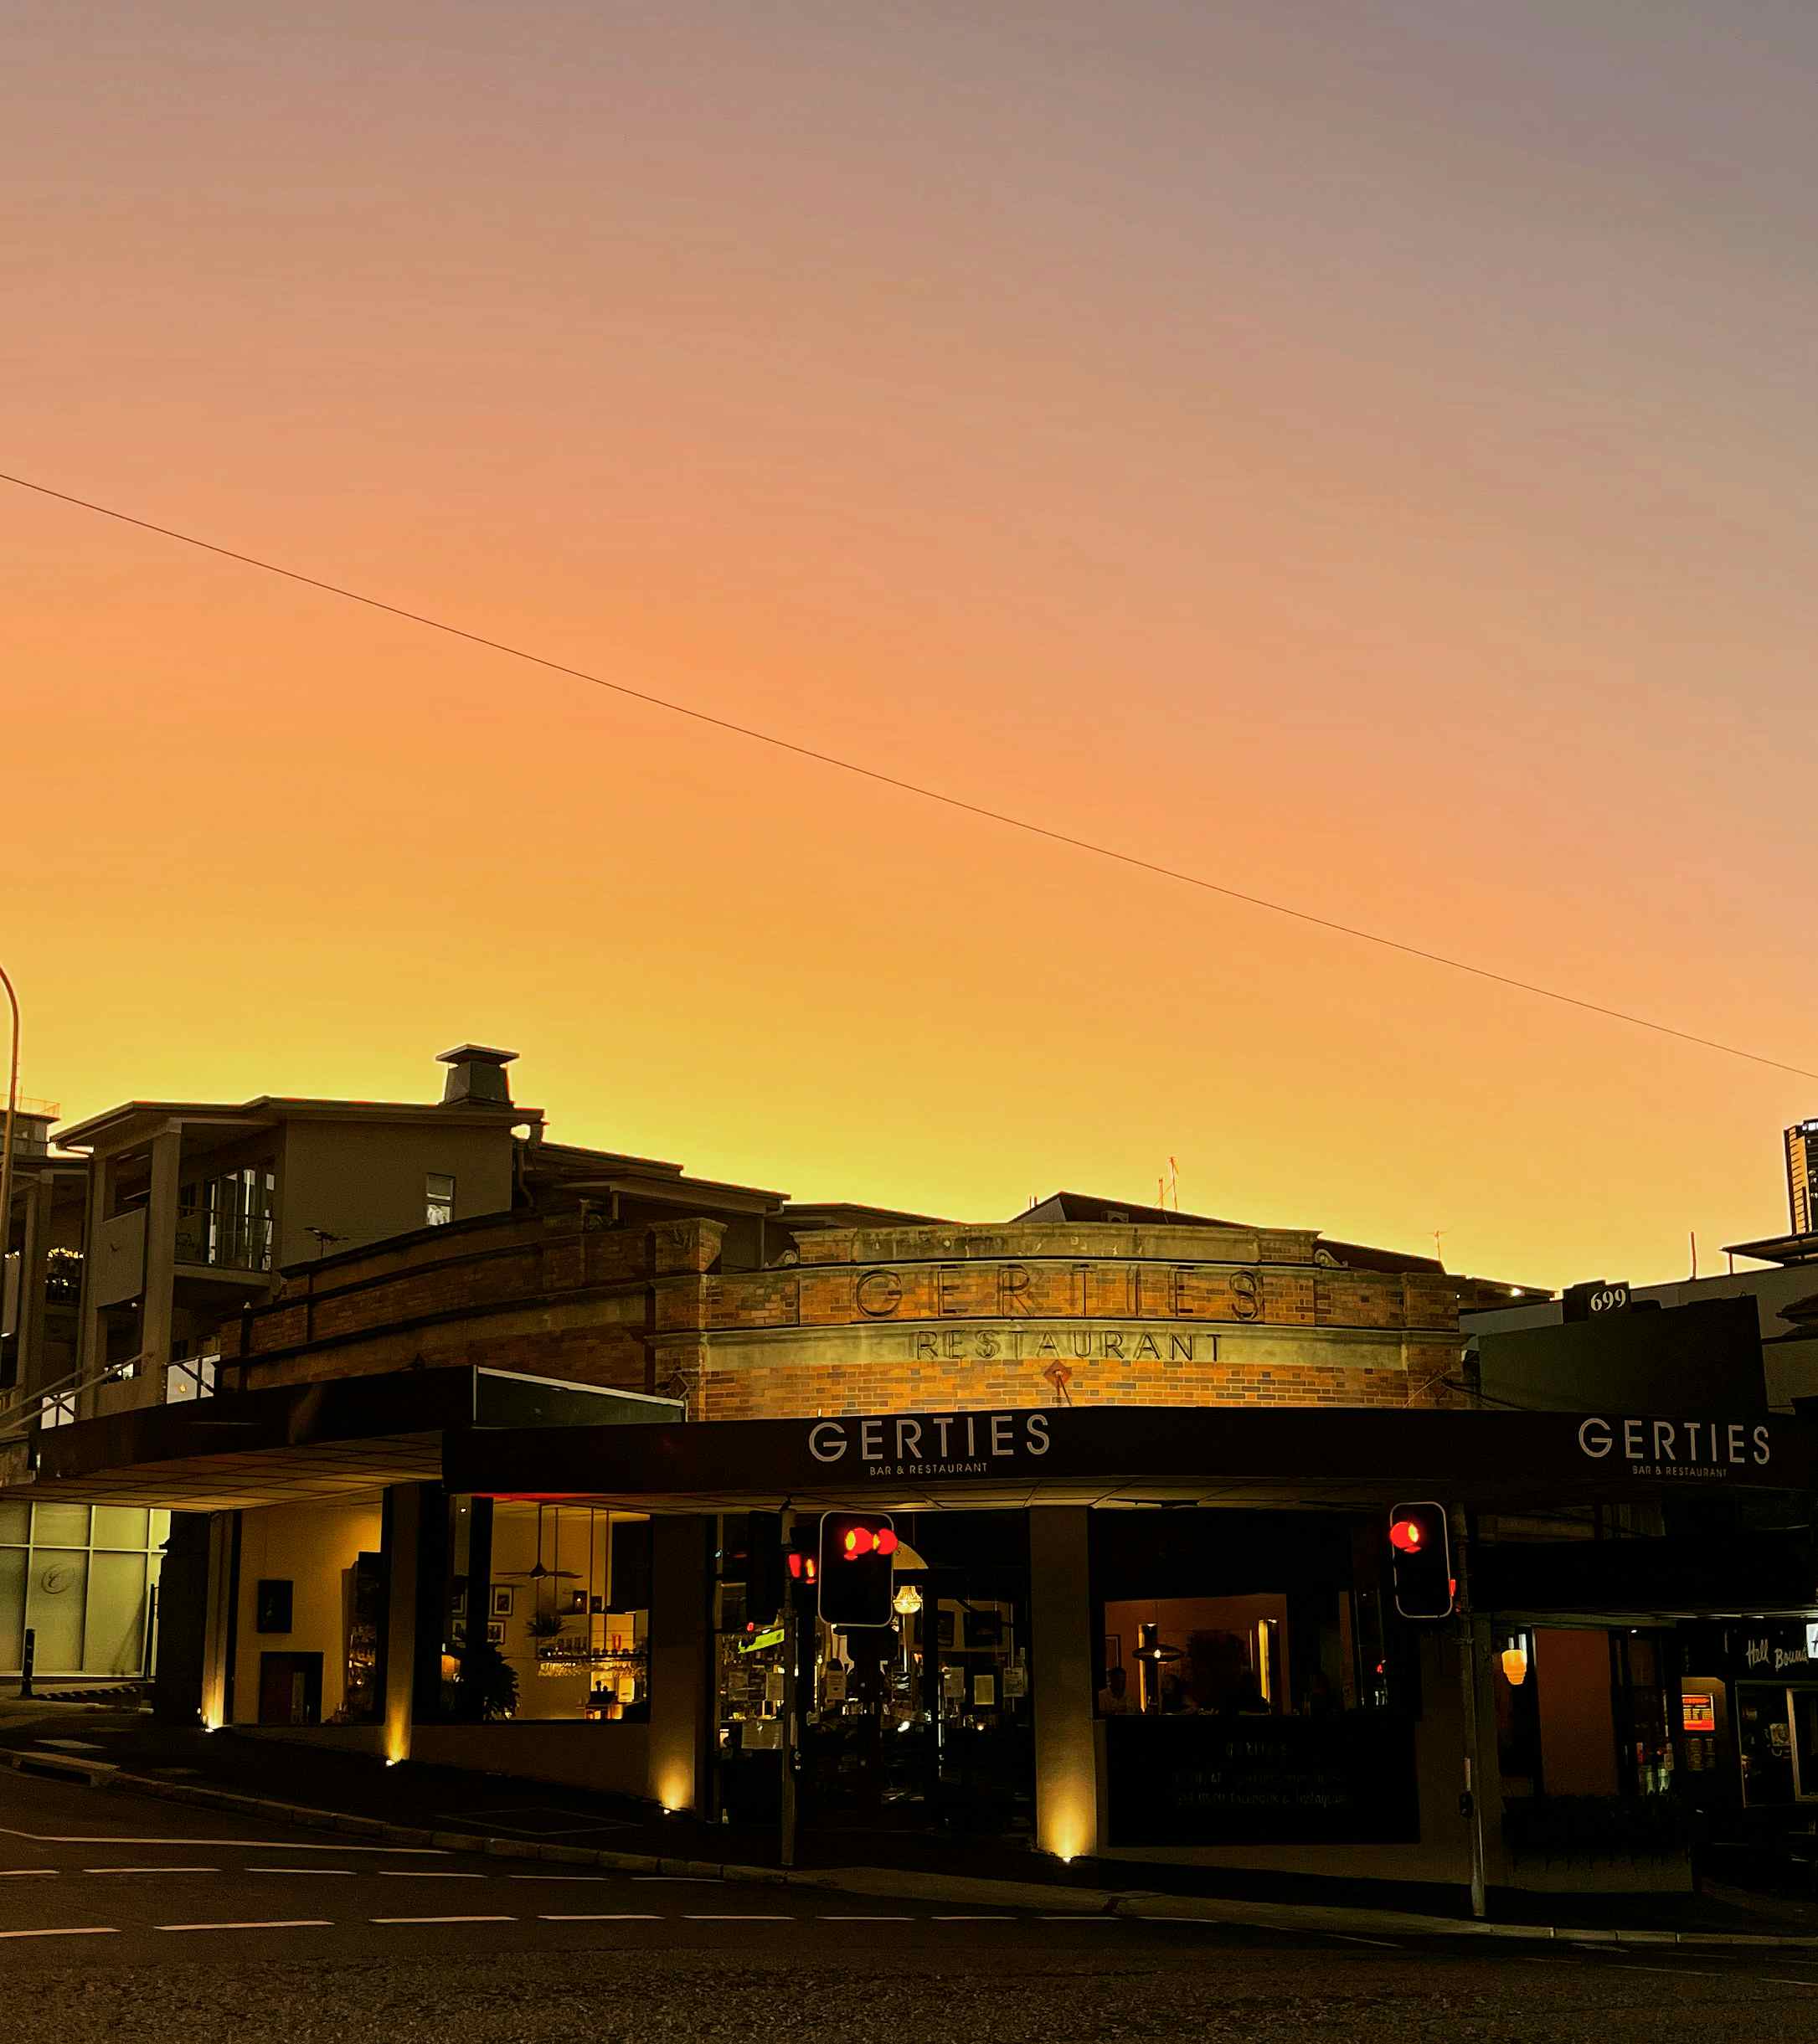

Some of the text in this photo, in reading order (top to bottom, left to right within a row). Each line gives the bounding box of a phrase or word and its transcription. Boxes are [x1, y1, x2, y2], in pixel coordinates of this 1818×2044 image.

[854, 1262, 1263, 1321] GERTIES
[1590, 1289, 1626, 1311] 699
[917, 1330, 1222, 1362] RESTAURANT
[808, 1413, 1050, 1463] GERTIES
[1579, 1418, 1771, 1465] GERTIES
[869, 1462, 988, 1476] BAR & RESTAURANT
[1632, 1465, 1728, 1479] BAR & RESTAURANT
